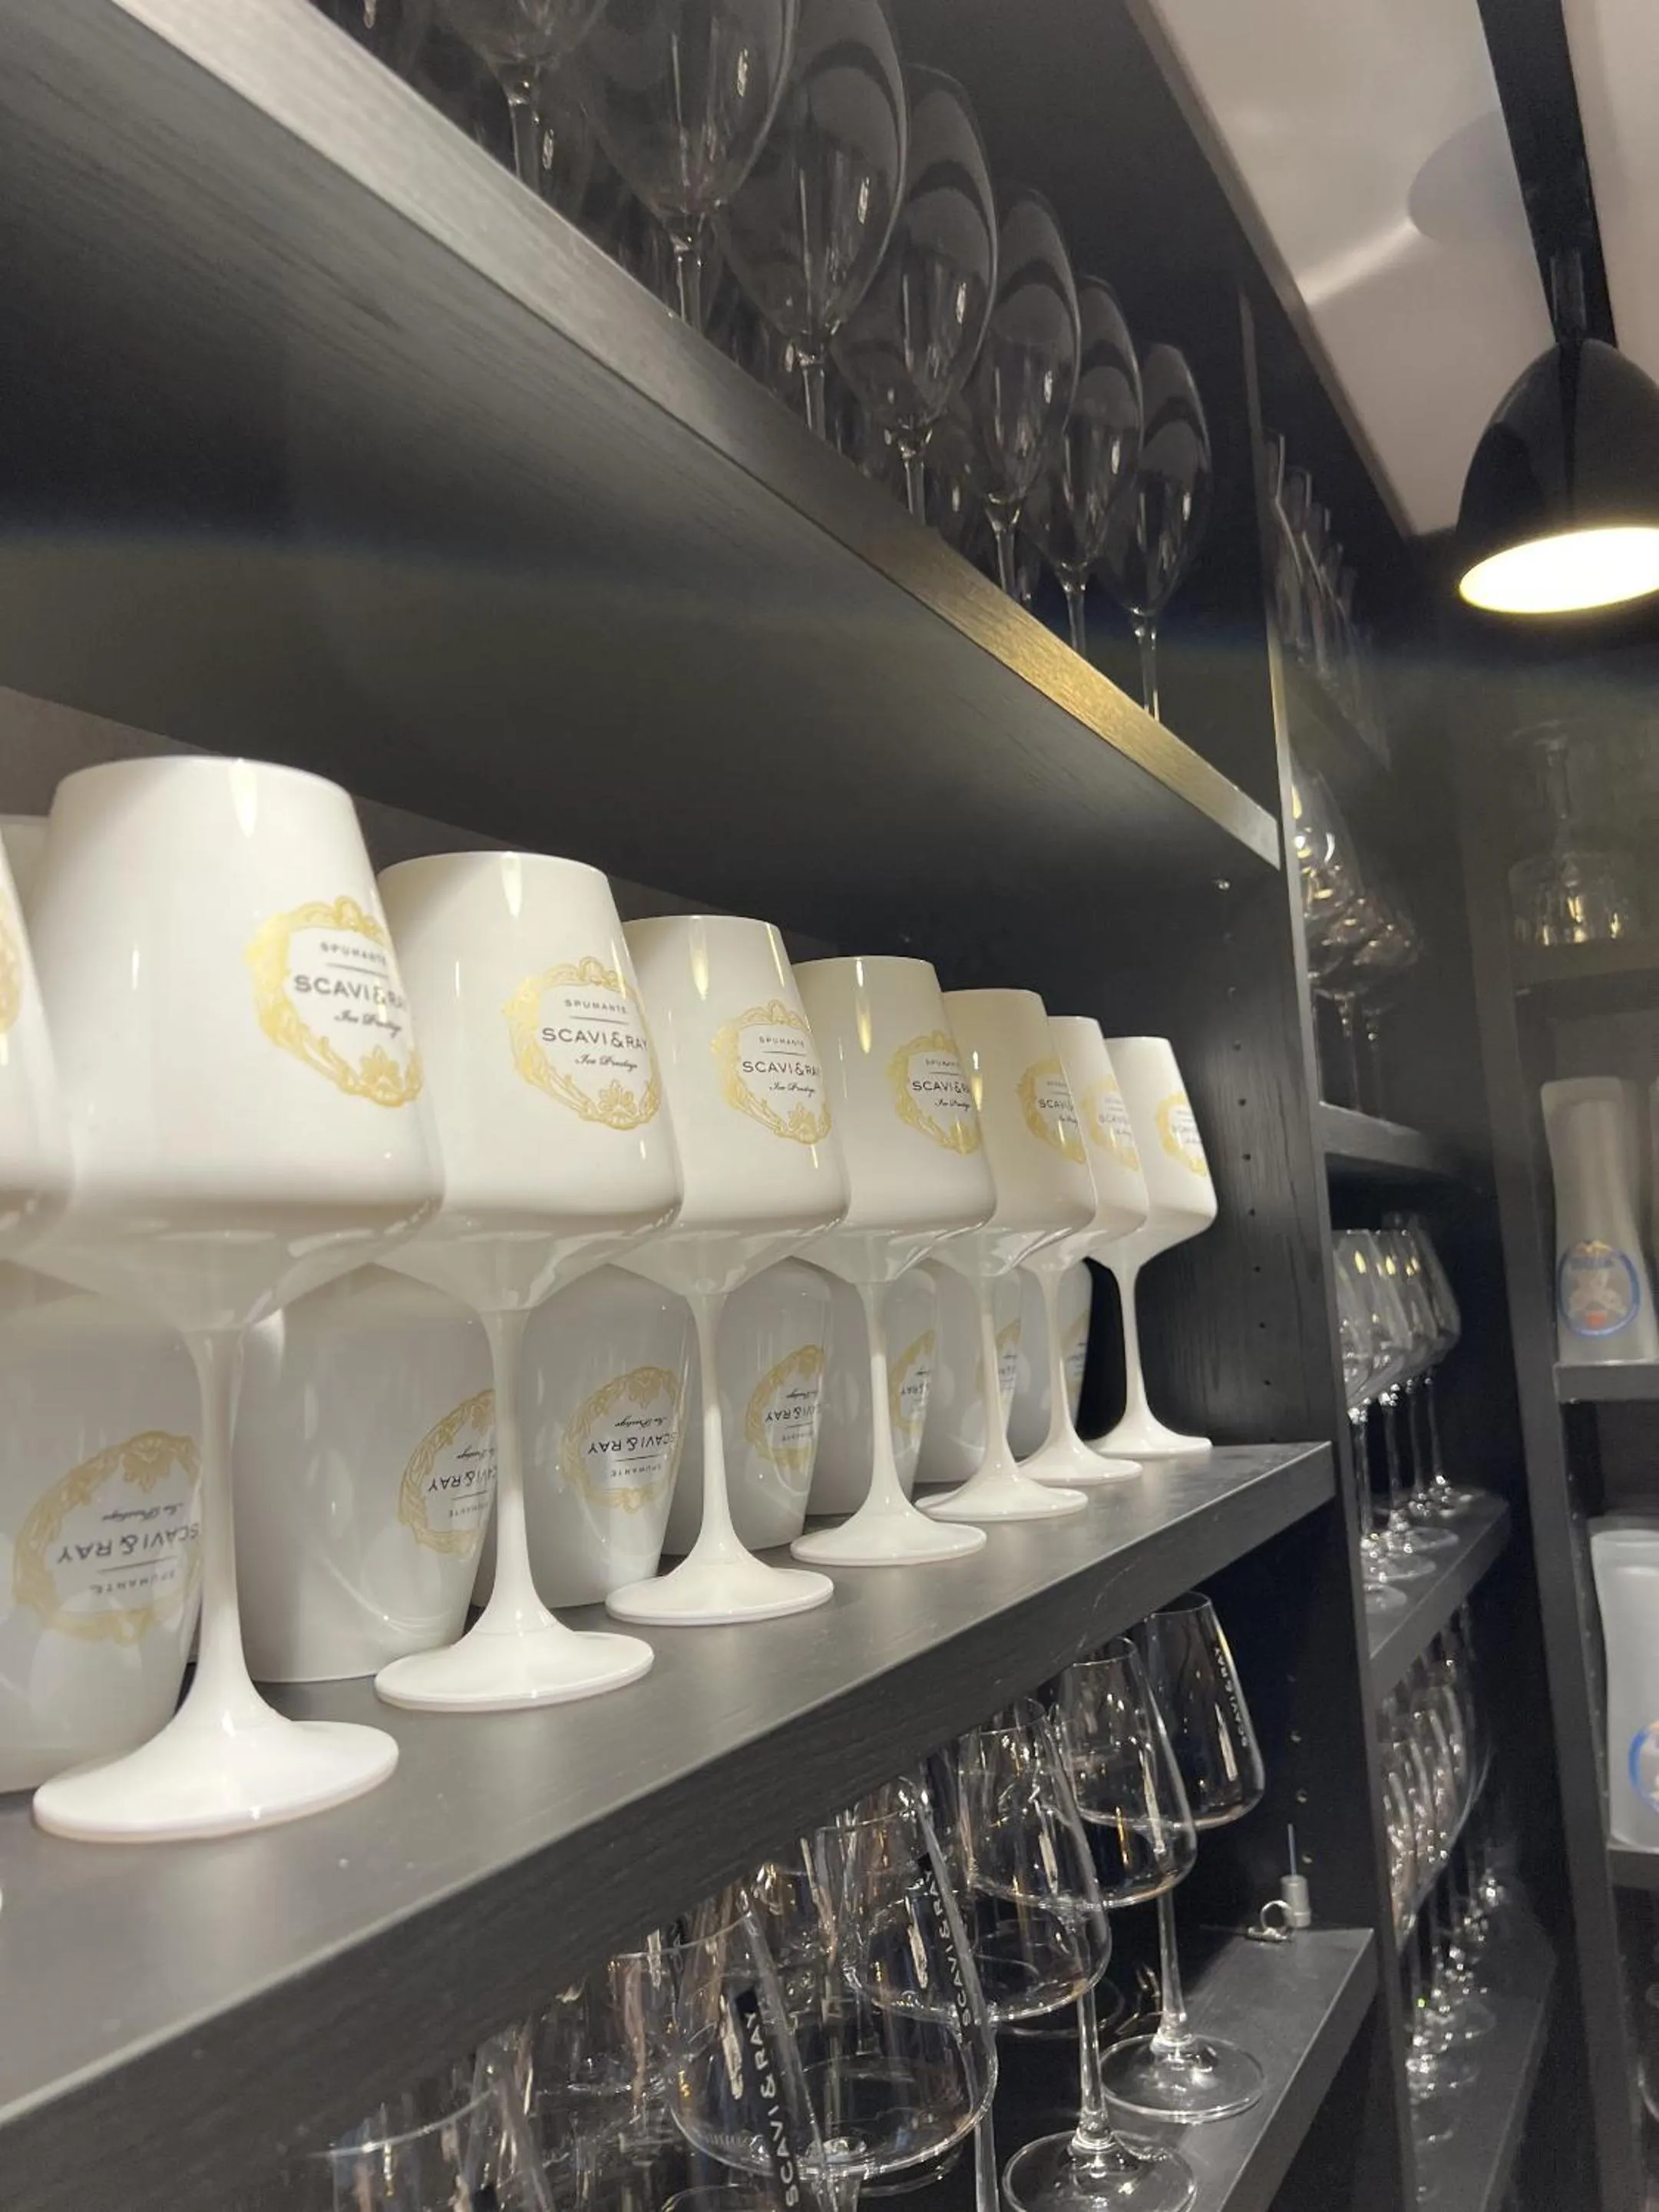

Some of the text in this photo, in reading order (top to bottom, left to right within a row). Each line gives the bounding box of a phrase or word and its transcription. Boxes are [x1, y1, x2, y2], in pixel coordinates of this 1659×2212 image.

[294, 974, 369, 1001] SCAVI
[542, 1027, 607, 1045] SCAVI
[742, 1061, 792, 1074] SCAVI
[587, 1440, 622, 1454] RAY
[640, 1431, 676, 1448] CAVI
[428, 1476, 461, 1492] RAY
[57, 1538, 112, 1565] RAY
[924, 1870, 944, 1916] RAY
[944, 1944, 971, 2026] SCAVI
[744, 2011, 768, 2071] RAY
[767, 2105, 800, 2207] SCAVI
